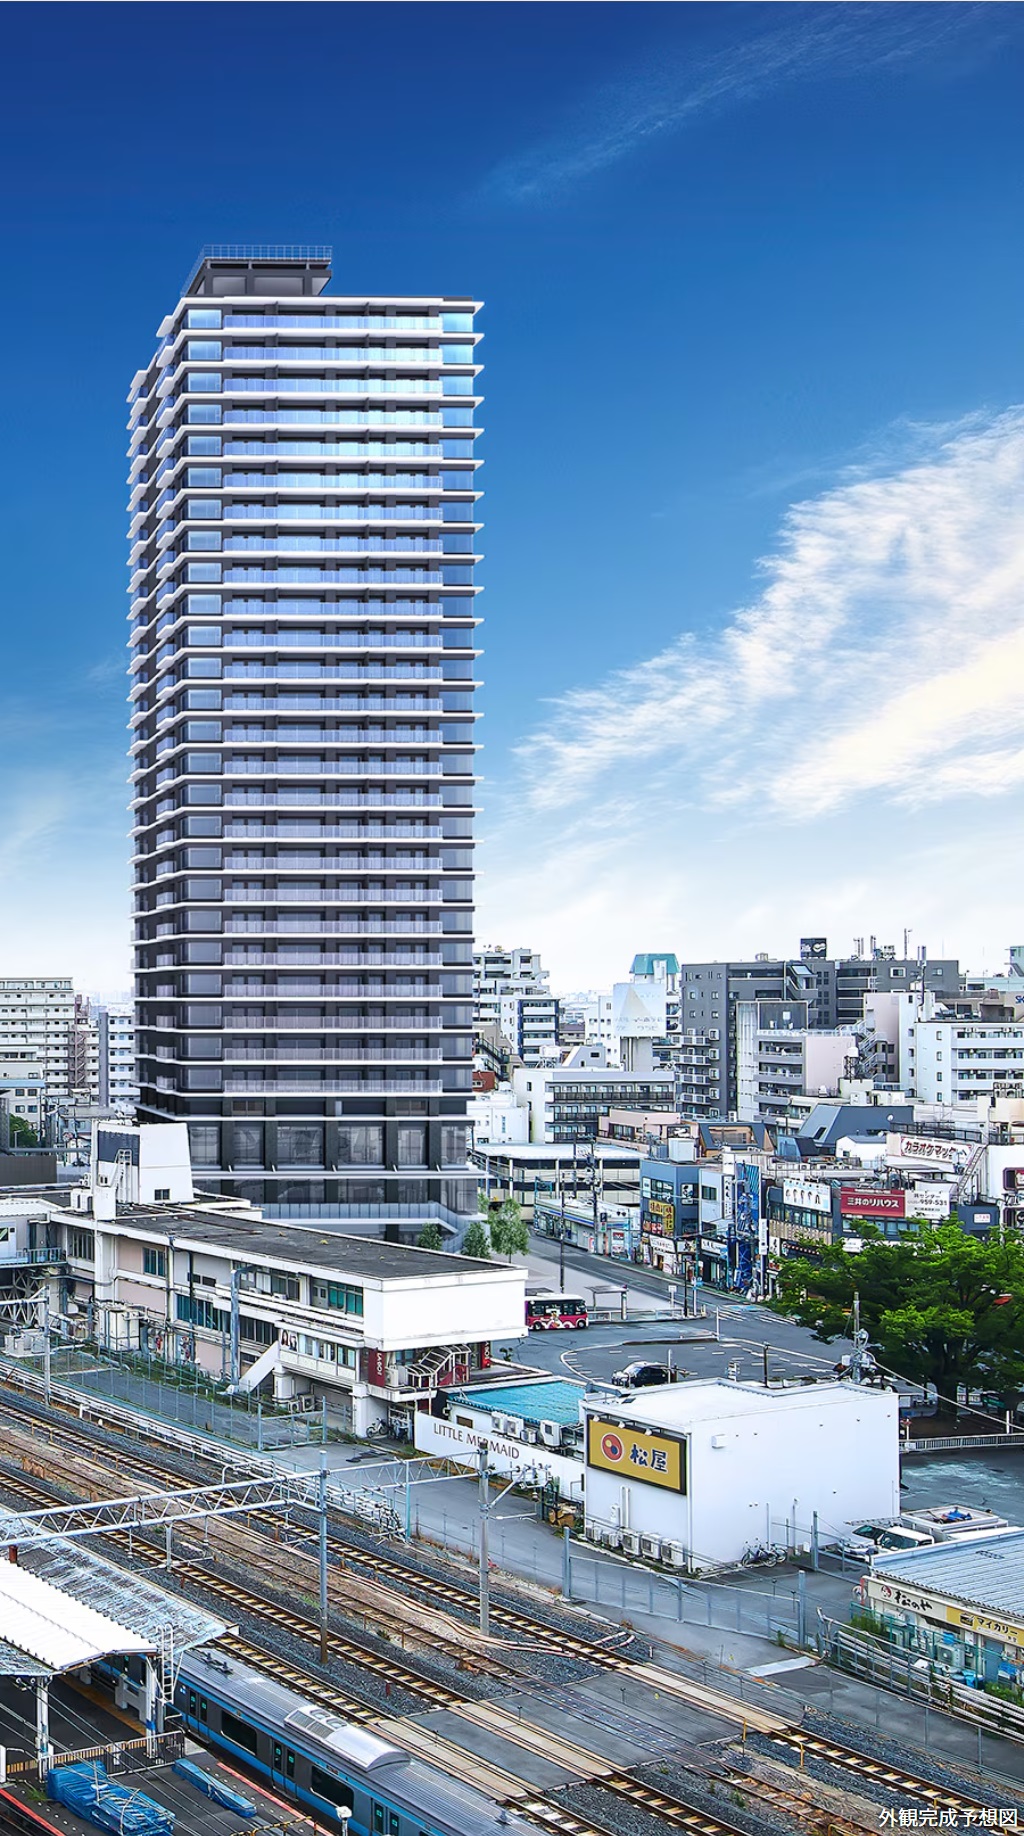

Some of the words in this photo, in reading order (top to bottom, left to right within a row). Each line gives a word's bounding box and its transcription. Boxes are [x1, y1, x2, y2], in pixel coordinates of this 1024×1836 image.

[847, 1197, 899, 1208] 三井のリハウス
[434, 1422, 464, 1443] LITTLE
[629, 1442, 668, 1474] 松屋
[894, 1590, 933, 1611] 松のや
[976, 1617, 1018, 1635] マイカリー
